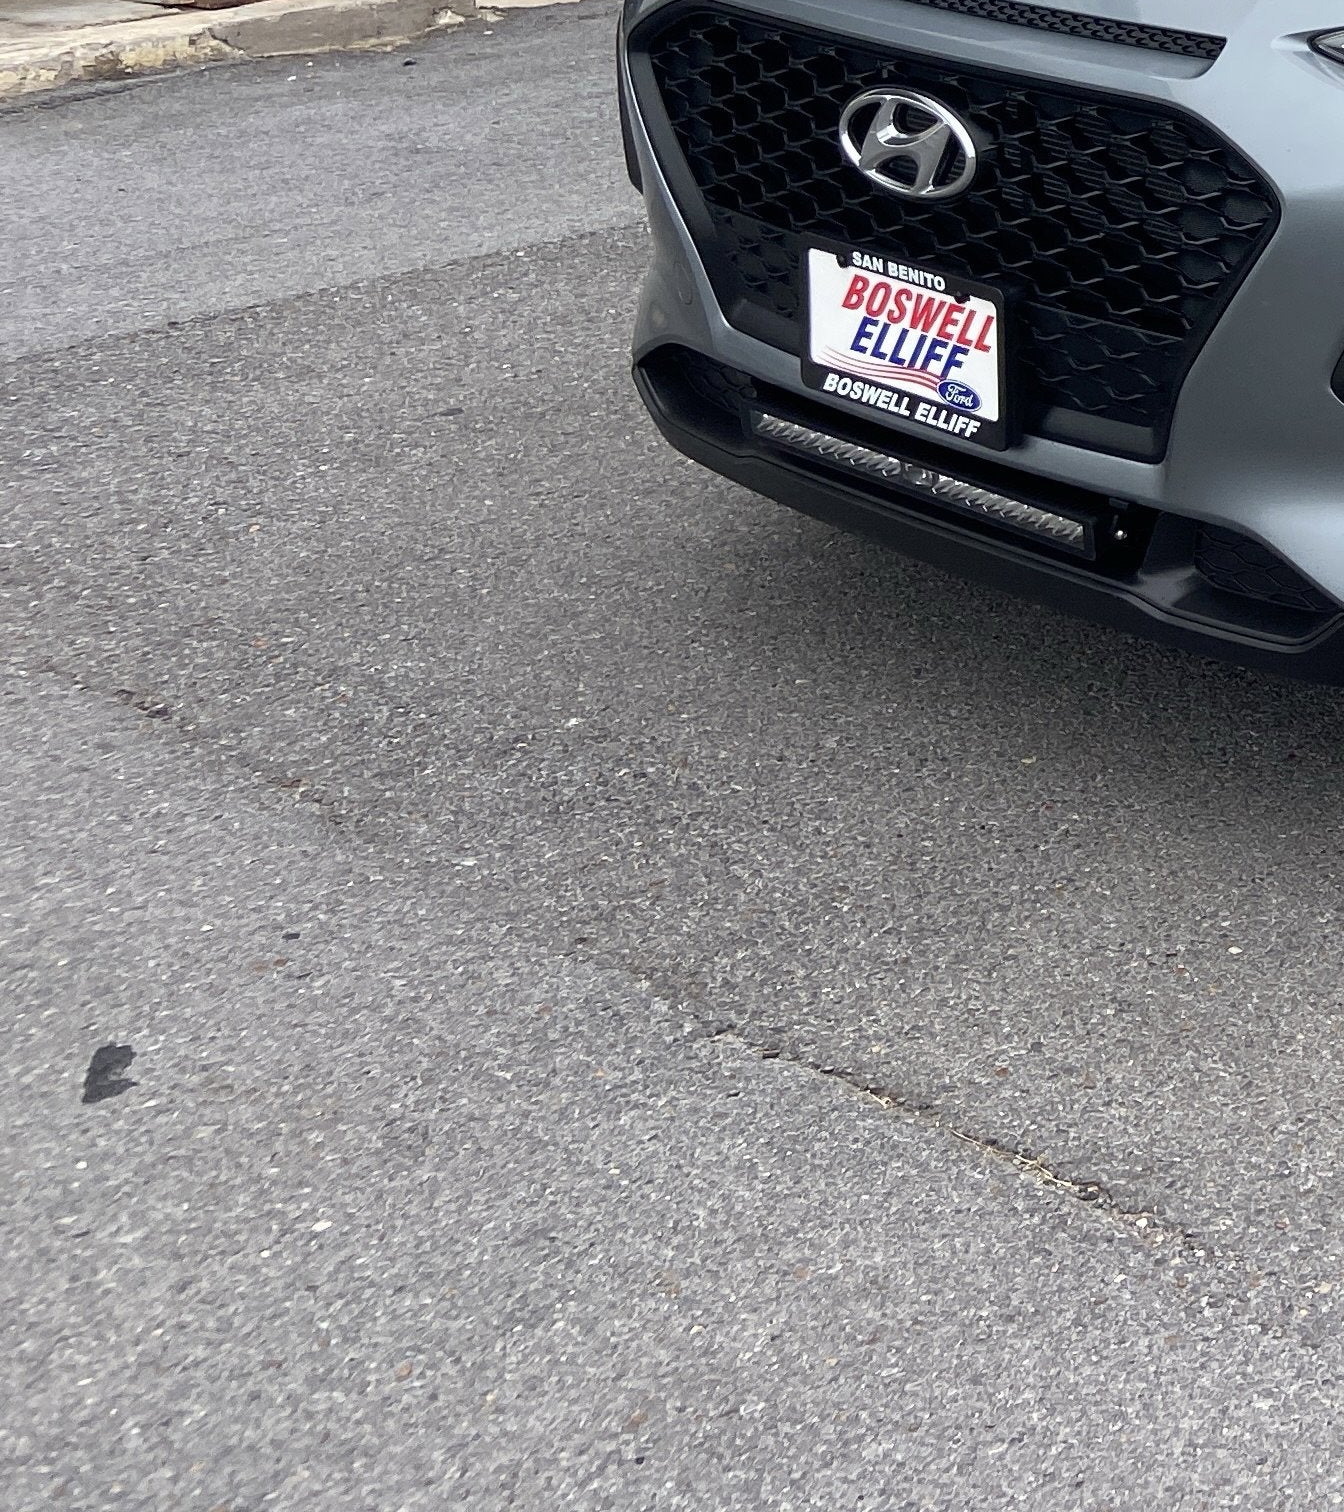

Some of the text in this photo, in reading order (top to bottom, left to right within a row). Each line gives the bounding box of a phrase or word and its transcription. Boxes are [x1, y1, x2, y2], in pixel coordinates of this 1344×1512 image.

[852, 251, 946, 292] SAN BENITO
[841, 274, 995, 353] BOSWELL
[850, 316, 969, 380] ELLIFF
[823, 372, 981, 438] BOSWELL ELLIFF
[945, 384, 974, 408] Ford
